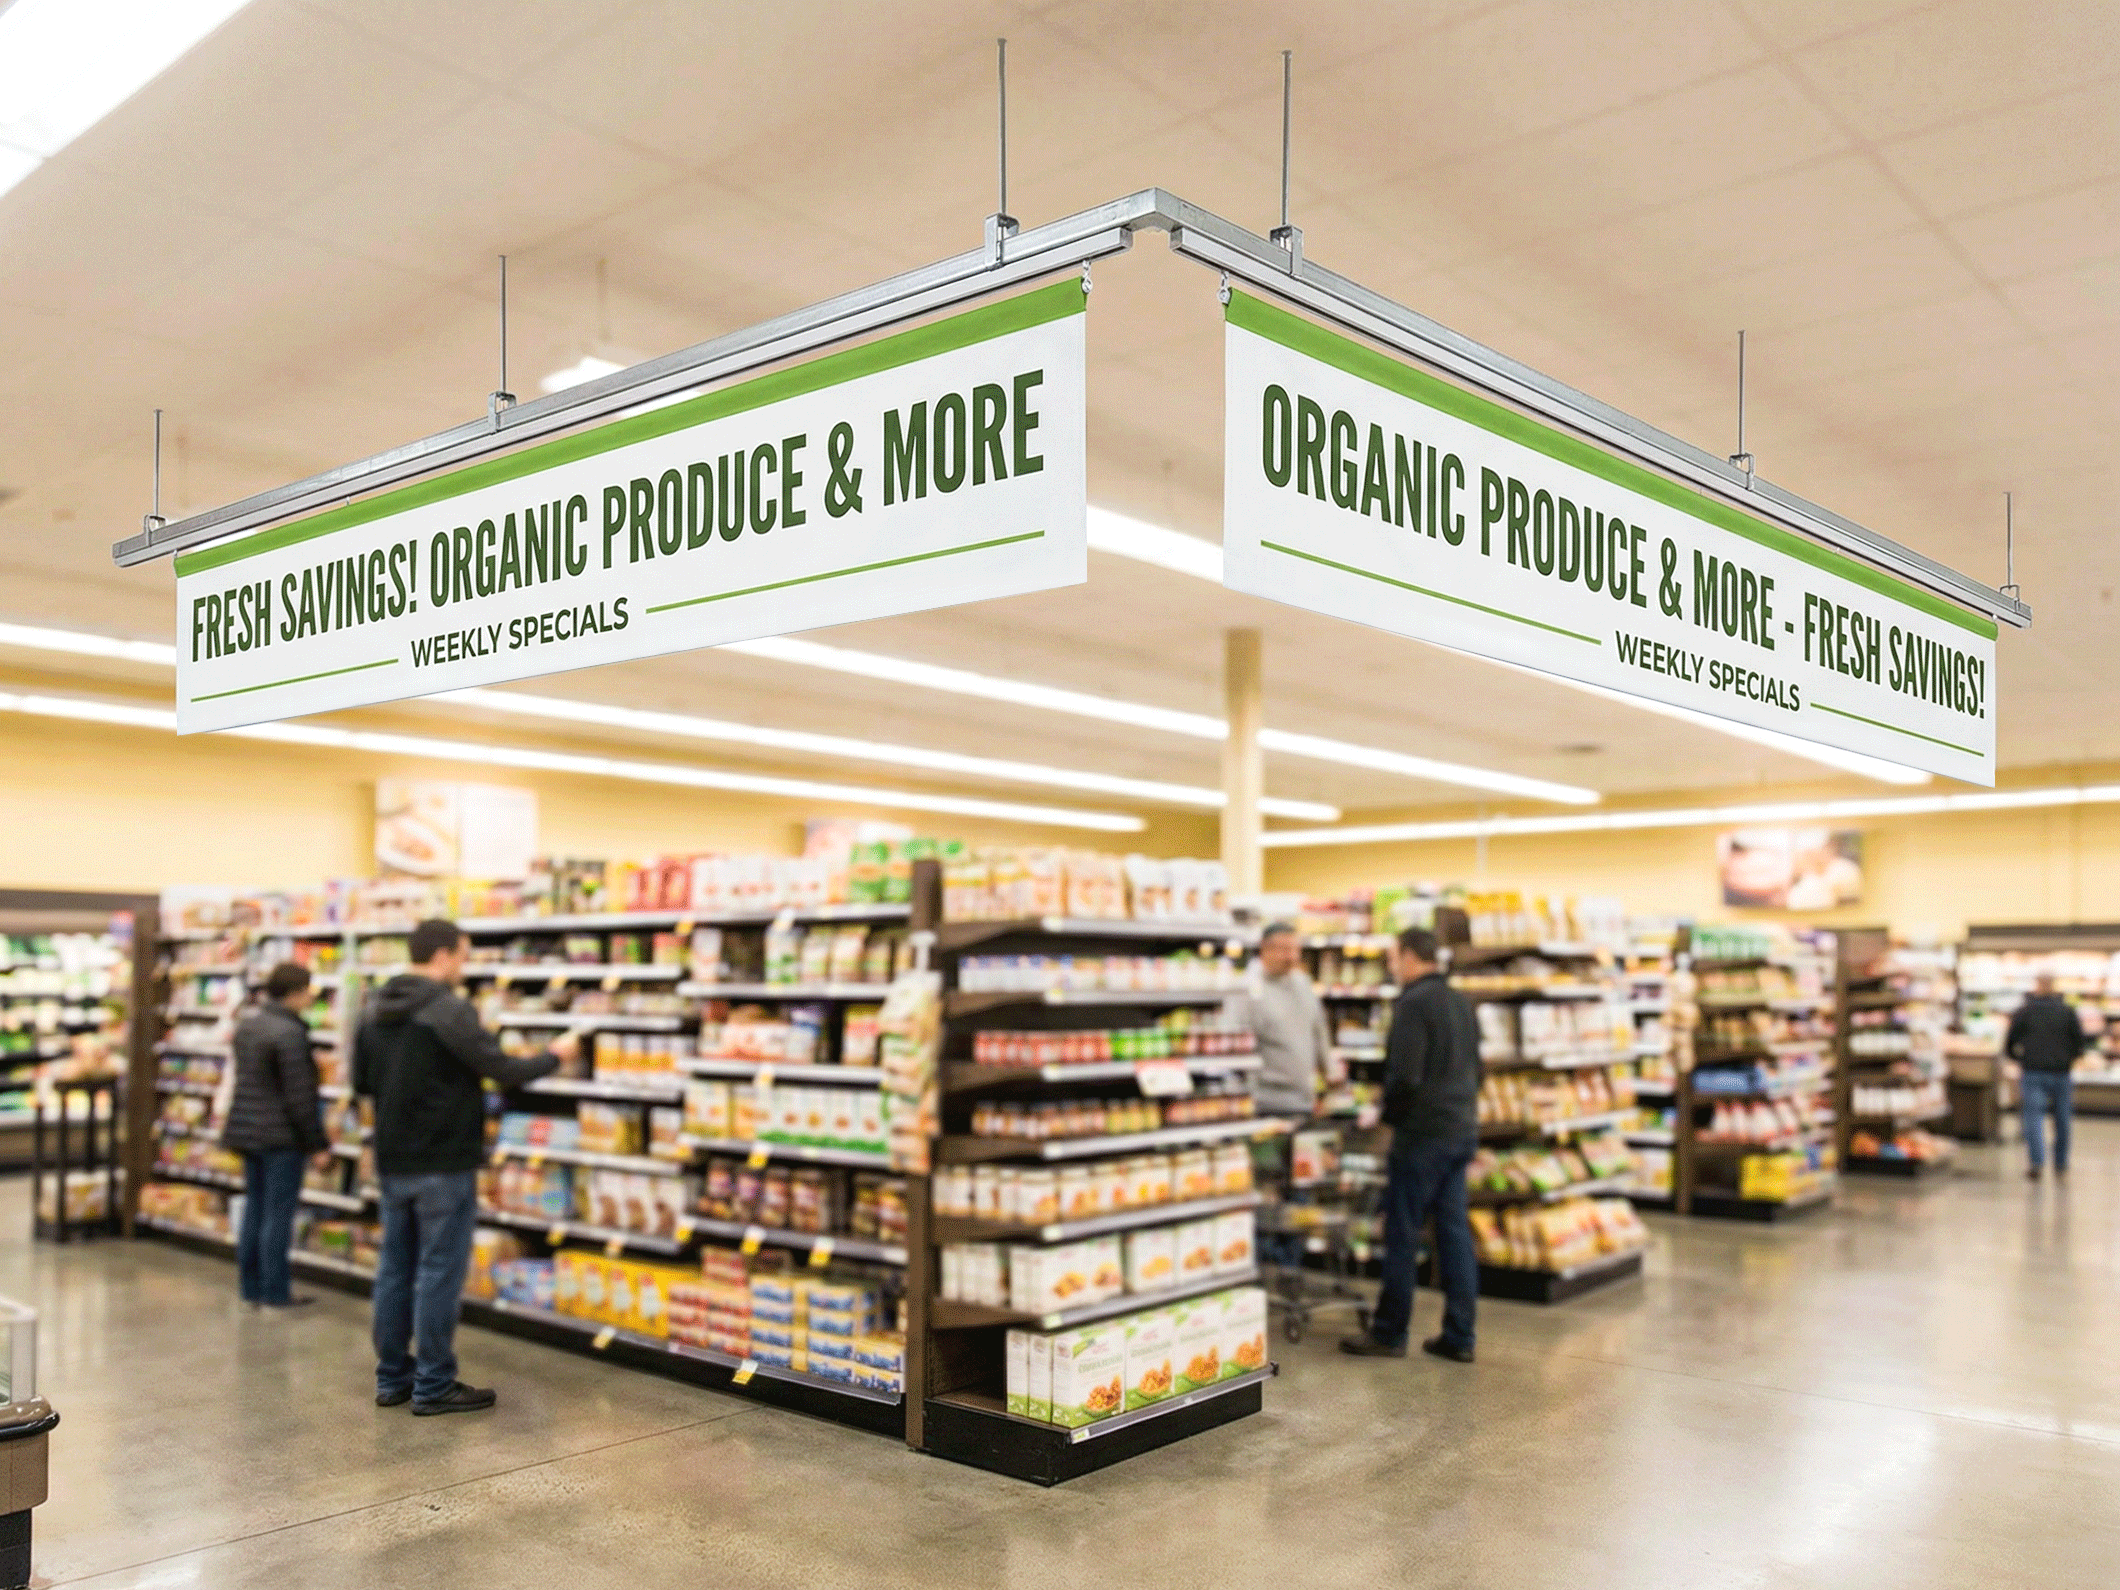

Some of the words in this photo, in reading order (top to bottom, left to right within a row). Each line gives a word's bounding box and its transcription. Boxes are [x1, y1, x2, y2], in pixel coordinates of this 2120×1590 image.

[191, 578, 272, 663] FRESH
[280, 539, 418, 642] SAVINGS!
[430, 494, 588, 608] ORGANIC
[603, 433, 807, 570] PRODUCE
[824, 421, 864, 519] &
[883, 368, 1044, 507] MORE
[1262, 384, 1466, 547] ORGANIC
[1481, 466, 1647, 609] PRODUCE
[1658, 537, 1684, 621] &
[1693, 549, 1776, 651] MORE
[1784, 620, 1795, 635] -
[1804, 591, 1882, 686] FRESH
[1888, 625, 1986, 719] SAVINGS!
[410, 621, 504, 669] WEEKLY
[508, 596, 630, 651] SPECIALS
[1614, 630, 1705, 685] WEEKLY
[1708, 659, 1801, 712] SPECIALS
